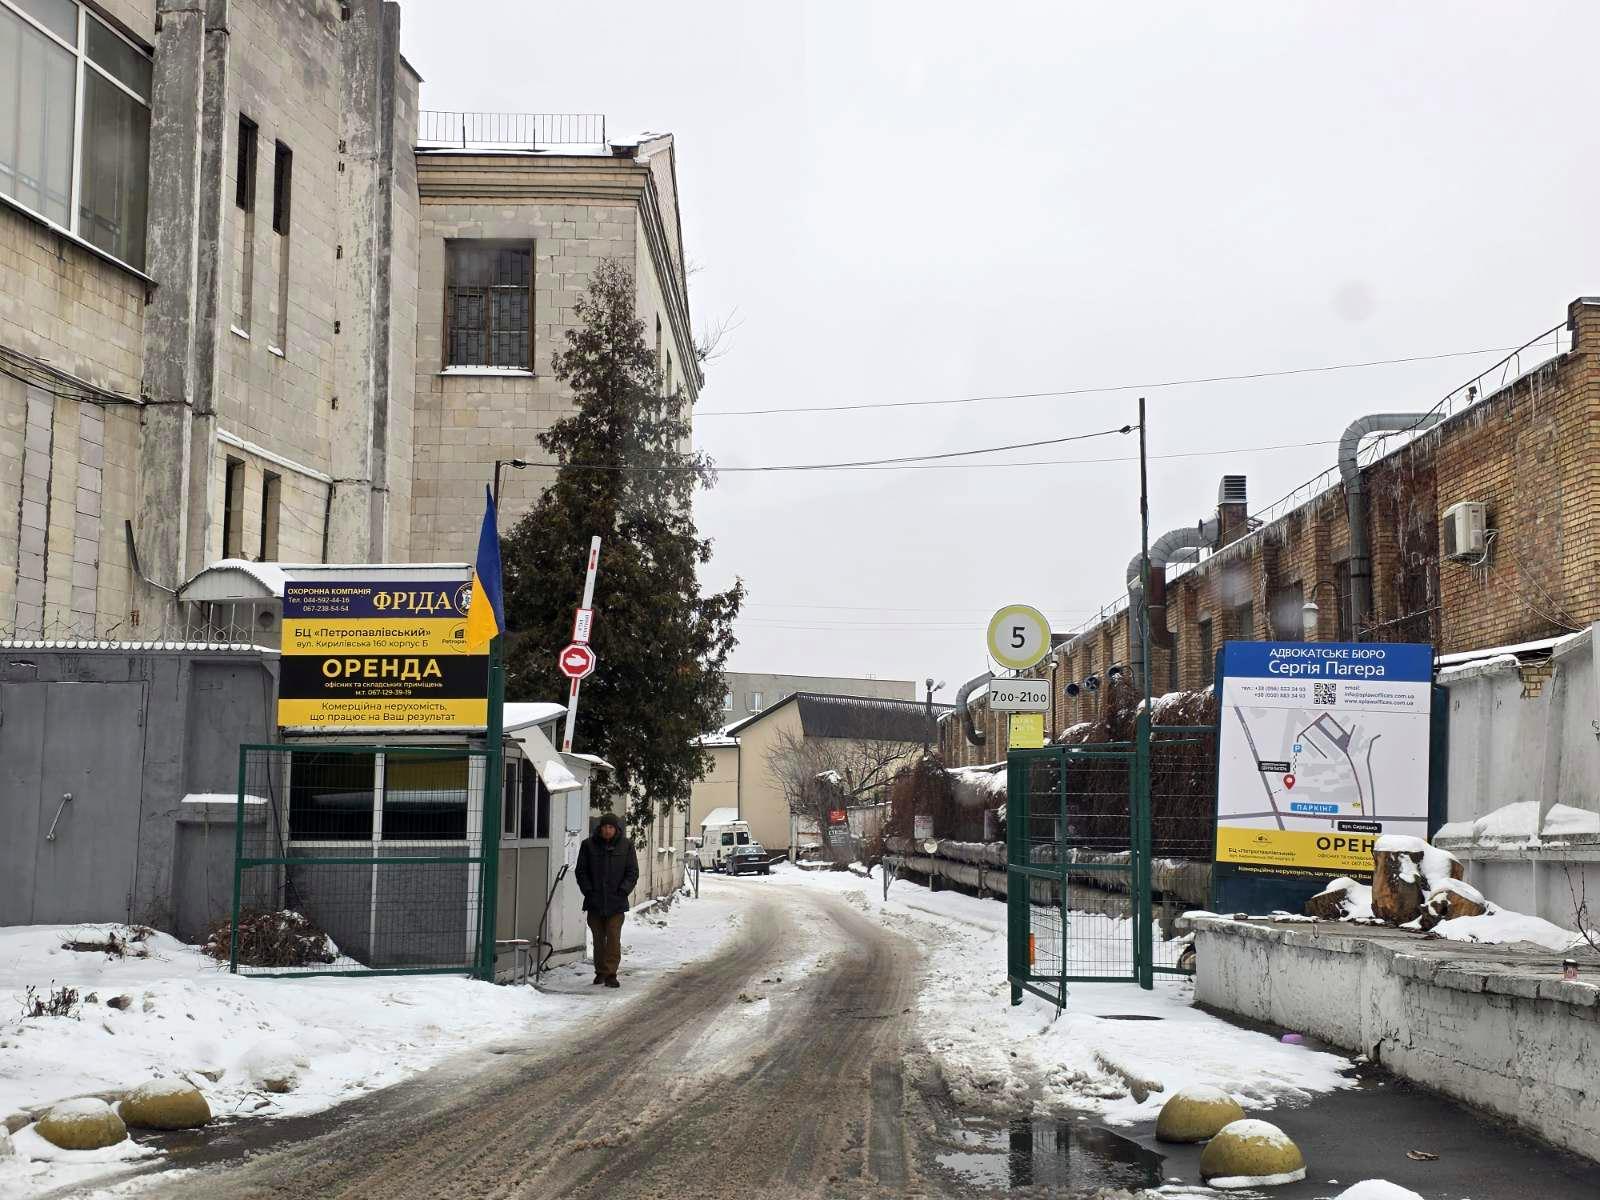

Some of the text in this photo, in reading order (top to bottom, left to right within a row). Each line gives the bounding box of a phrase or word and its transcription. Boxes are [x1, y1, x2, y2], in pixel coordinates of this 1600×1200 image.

[373, 592, 452, 614] ФРІДА
[295, 627, 431, 639] БЦ «Петропавлівський»
[1010, 626, 1025, 649] 5
[316, 640, 371, 648] Кирилівська
[389, 641, 420, 649] корпус
[1269, 648, 1386, 659] АДВОКАТСЬКЕ БЮРО
[322, 658, 443, 681] ОРЕНДА
[1269, 660, 1386, 678] Сергія Пагера
[321, 701, 382, 713] Комерційна
[310, 714, 324, 722] що
[325, 714, 367, 722] працює
[384, 712, 405, 721] Ваш
[407, 714, 456, 722] результат
[1296, 804, 1334, 812] ПАРКІНГ
